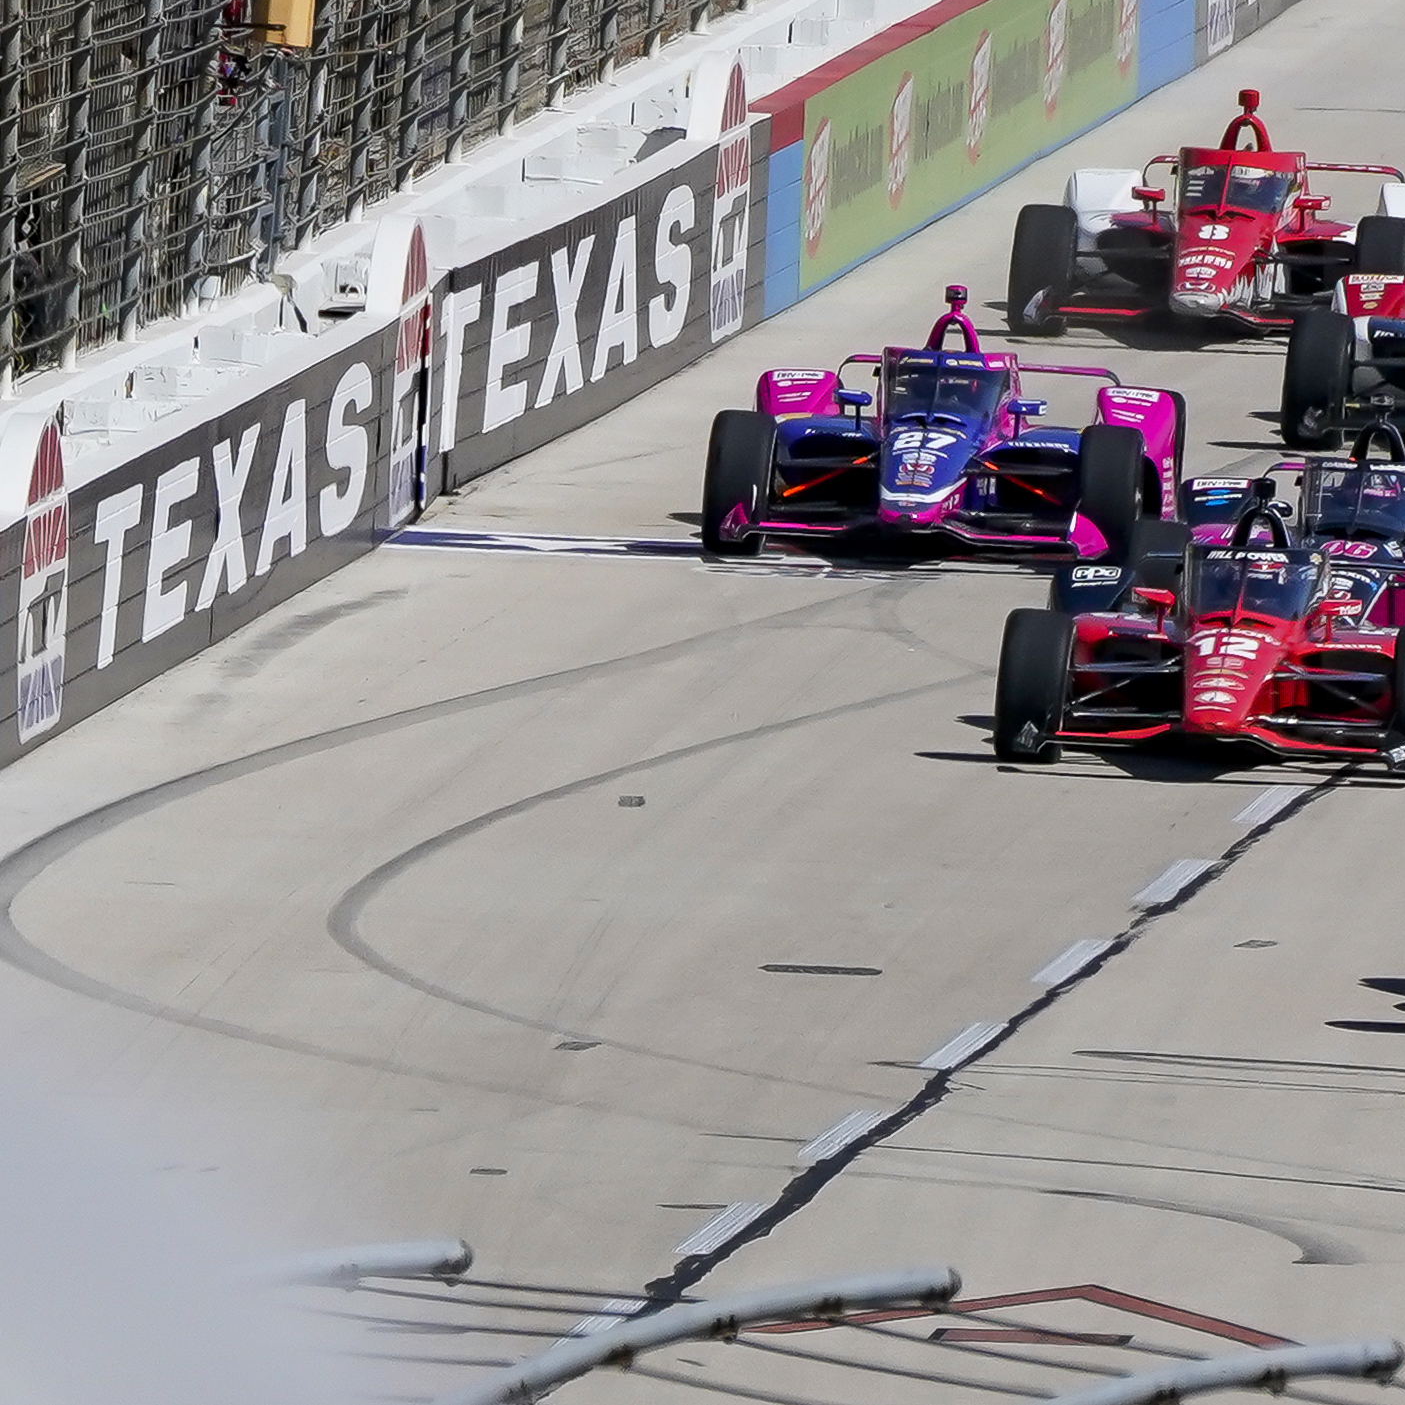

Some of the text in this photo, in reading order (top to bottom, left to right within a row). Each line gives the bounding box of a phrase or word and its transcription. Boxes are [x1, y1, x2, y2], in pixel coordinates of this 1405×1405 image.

[1198, 223, 1230, 240] 8
[440, 184, 696, 454] TEXAS
[891, 431, 957, 451] 27
[94, 362, 373, 670] TEXAS
[1076, 567, 1119, 579] PPG
[1194, 635, 1260, 660] 12
